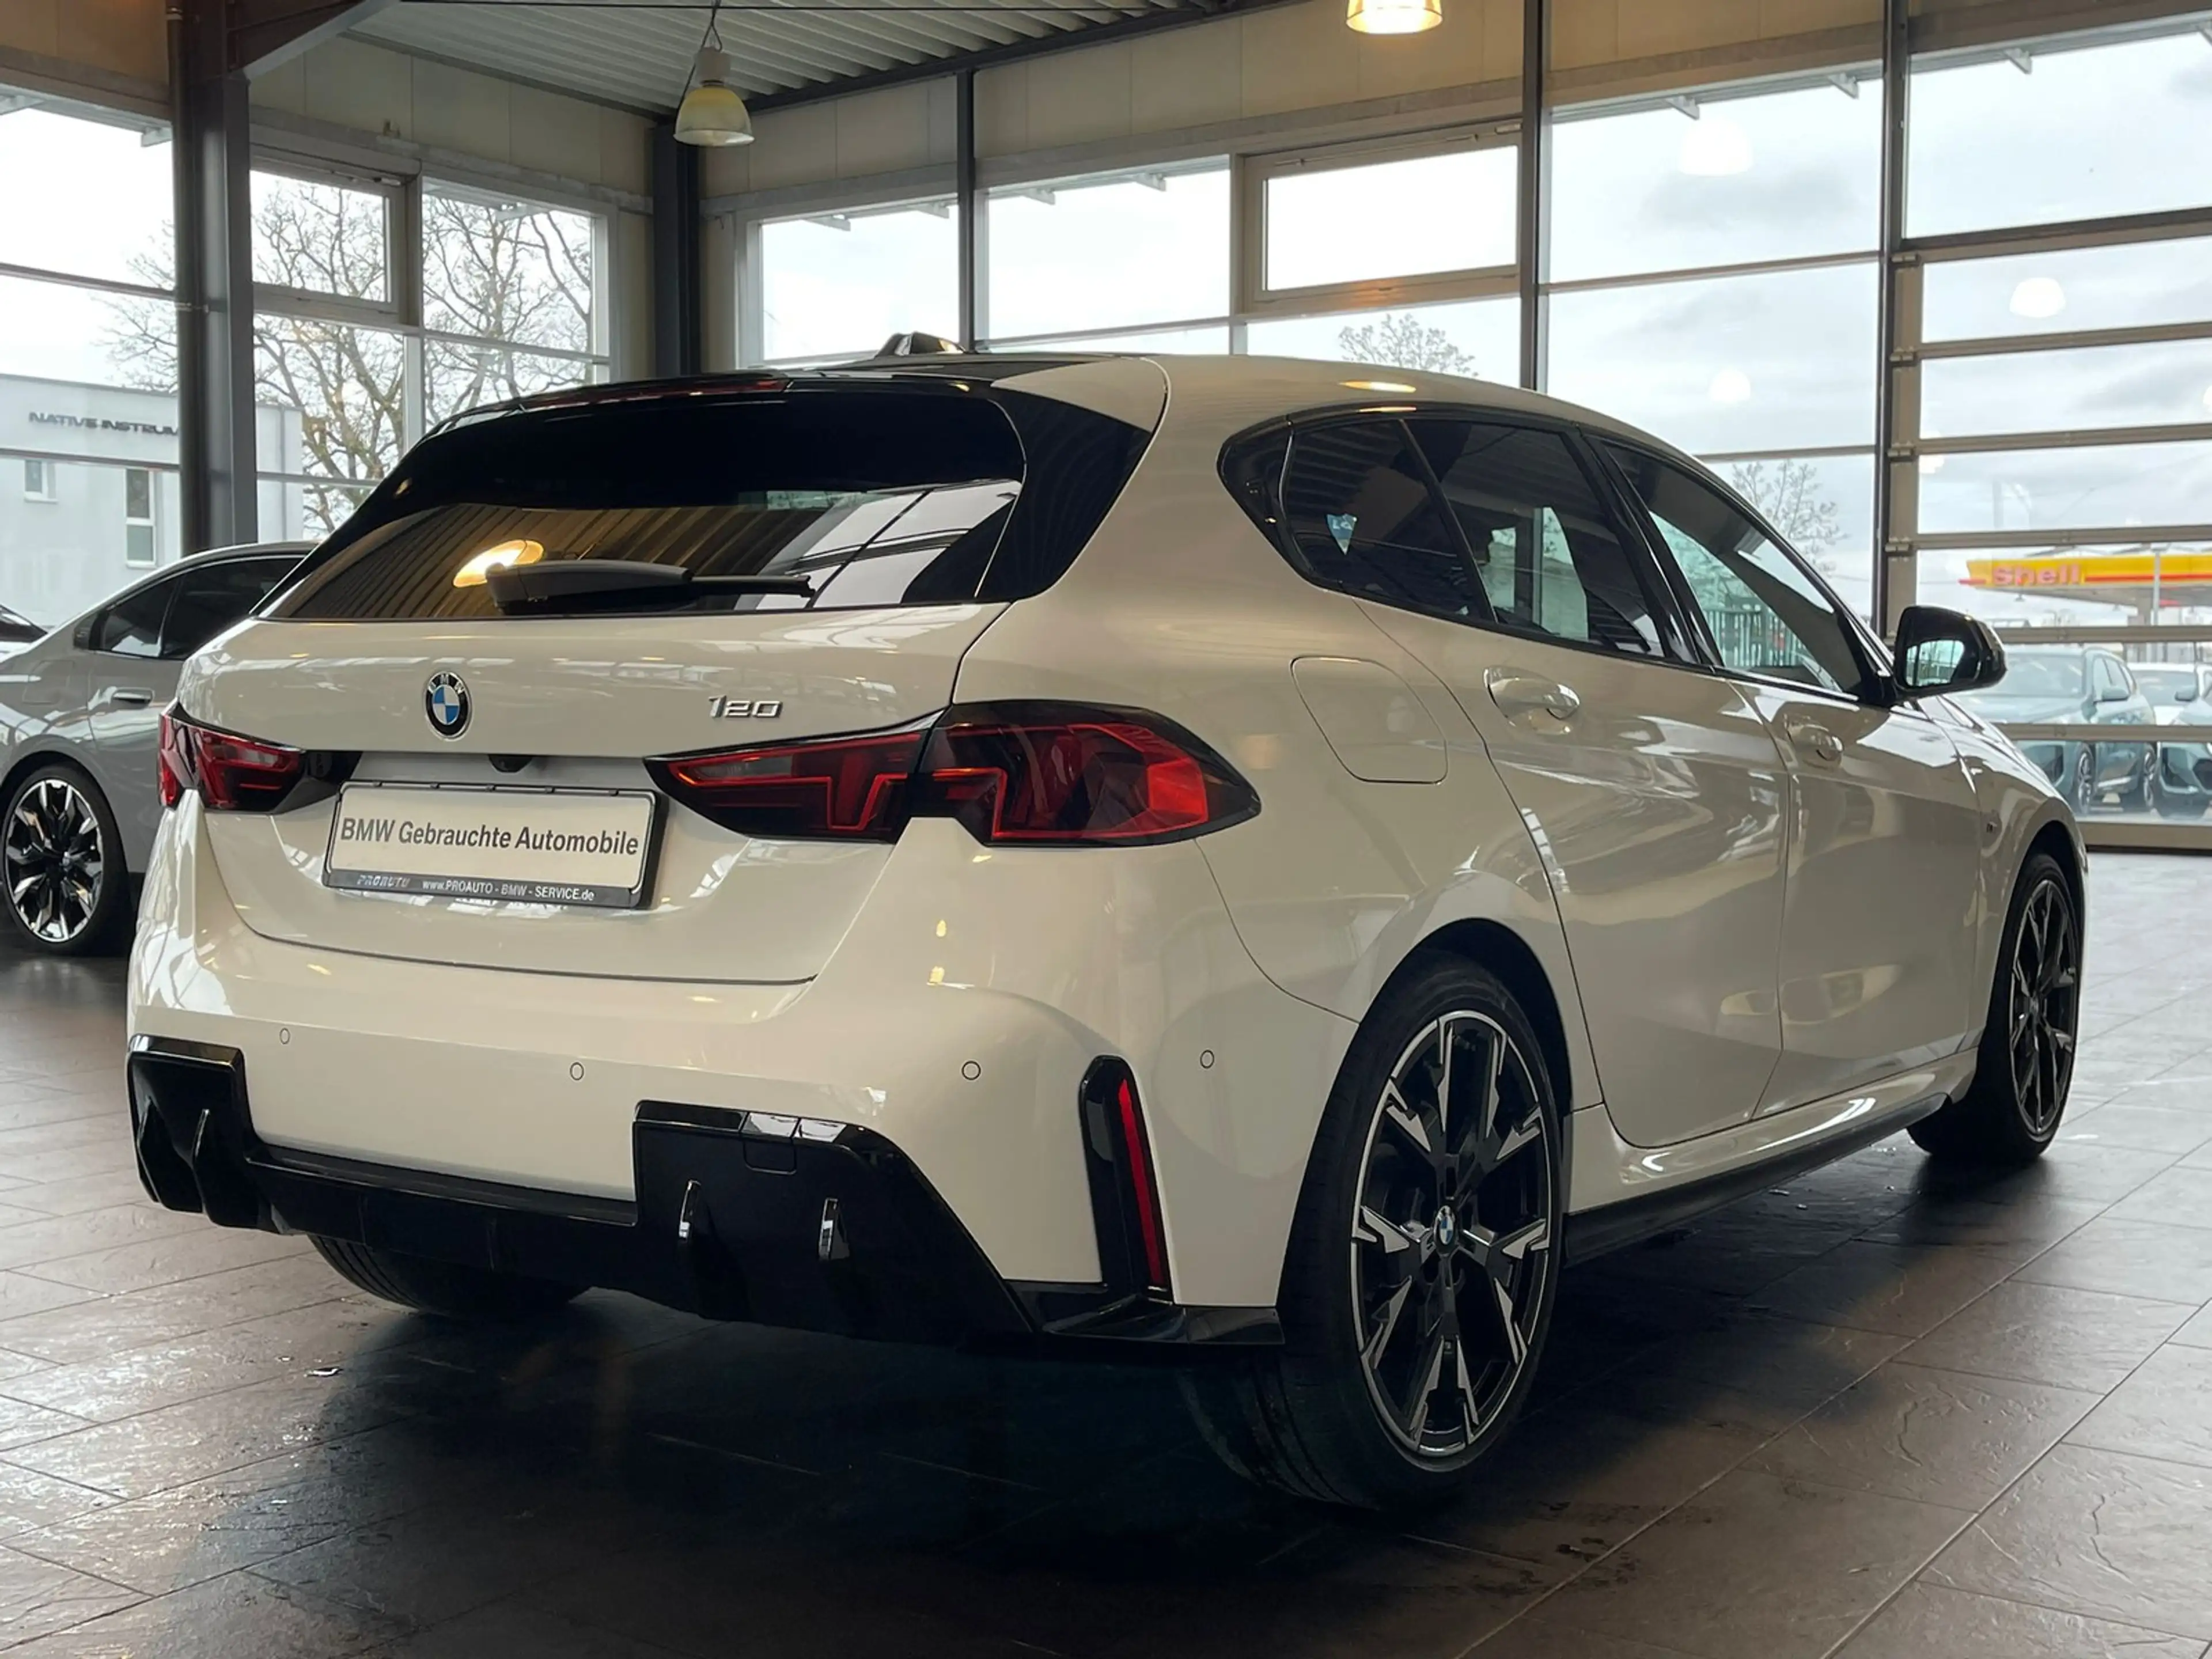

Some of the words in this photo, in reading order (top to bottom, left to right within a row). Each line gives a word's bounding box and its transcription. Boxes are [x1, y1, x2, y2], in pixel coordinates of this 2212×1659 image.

[29, 412, 97, 428] NATIVE
[1993, 563, 2080, 586] Shell
[428, 673, 465, 694] BMW
[708, 695, 783, 718] 120
[340, 817, 396, 842] BMW
[399, 820, 512, 849] Gebrauchte
[514, 826, 639, 855] Automobile
[501, 884, 528, 896] BMW
[535, 885, 595, 902] SERVICE.de
